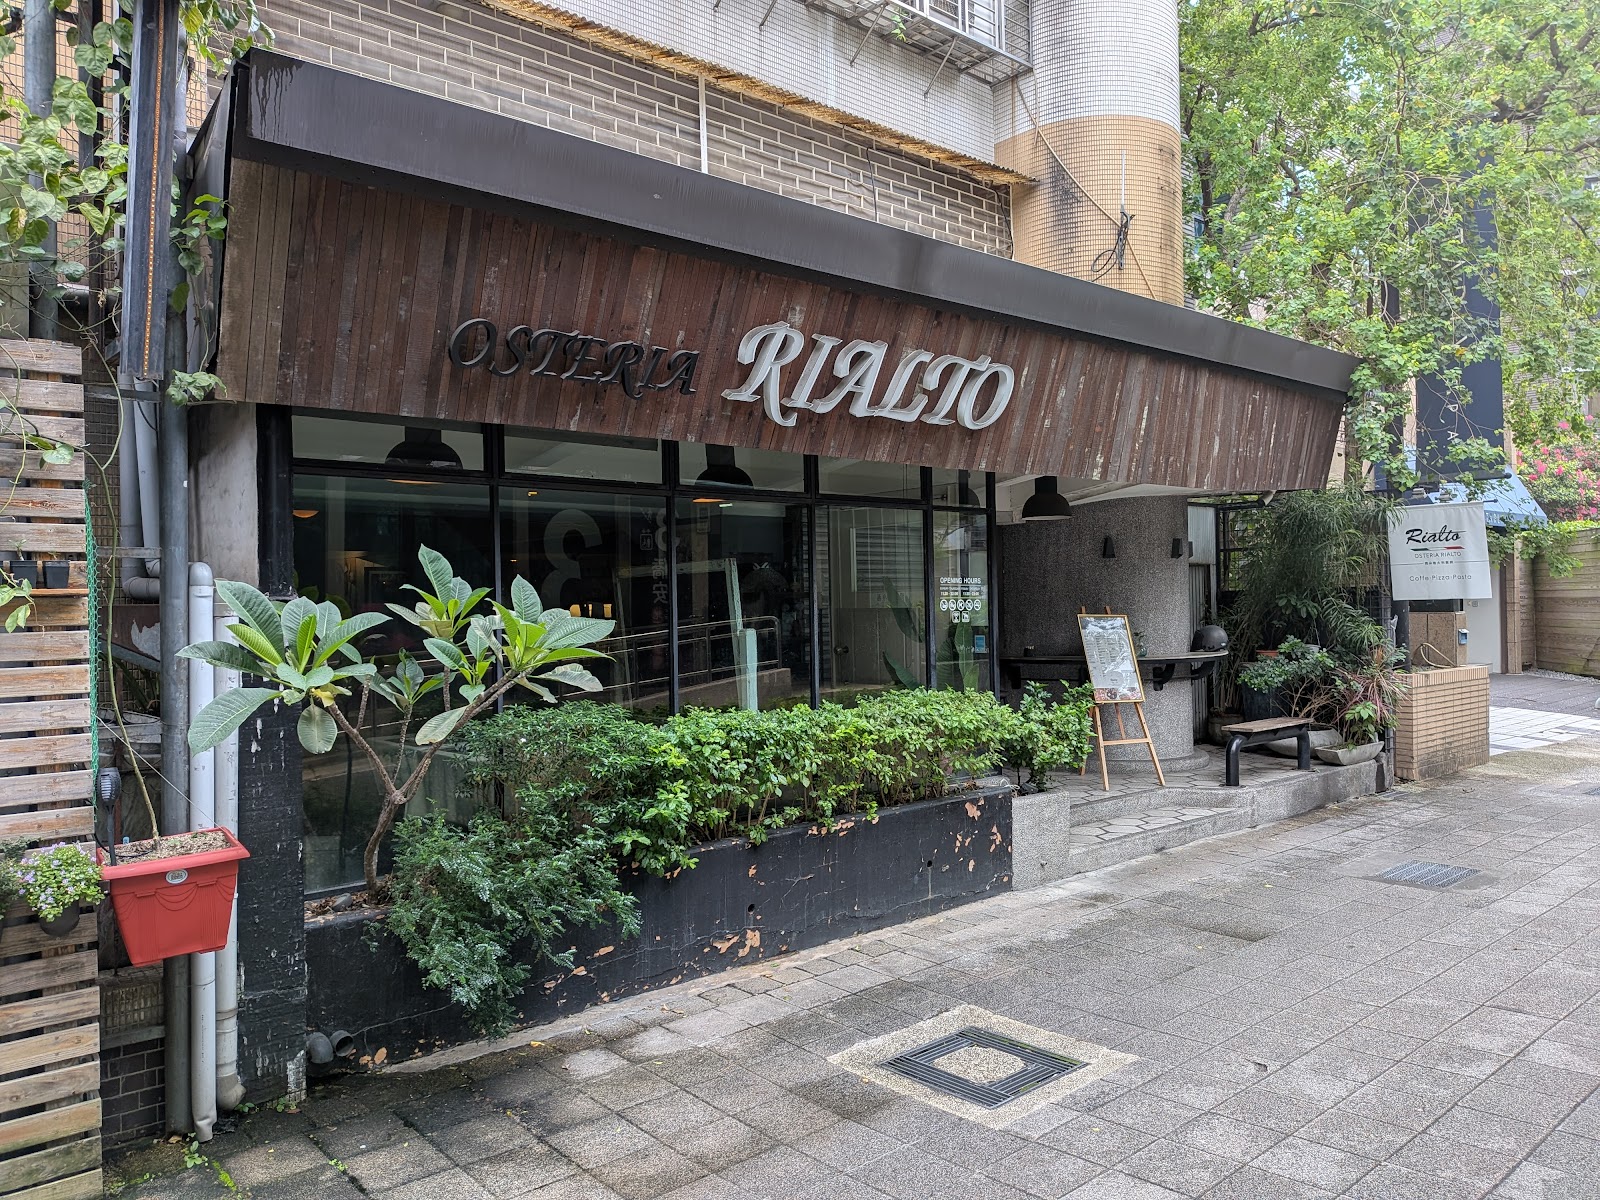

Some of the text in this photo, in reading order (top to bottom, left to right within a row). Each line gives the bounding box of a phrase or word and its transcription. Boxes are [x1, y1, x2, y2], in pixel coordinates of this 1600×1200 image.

[449, 318, 1015, 430] OSTERIA RIALTO
[1405, 524, 1467, 545] Rialto
